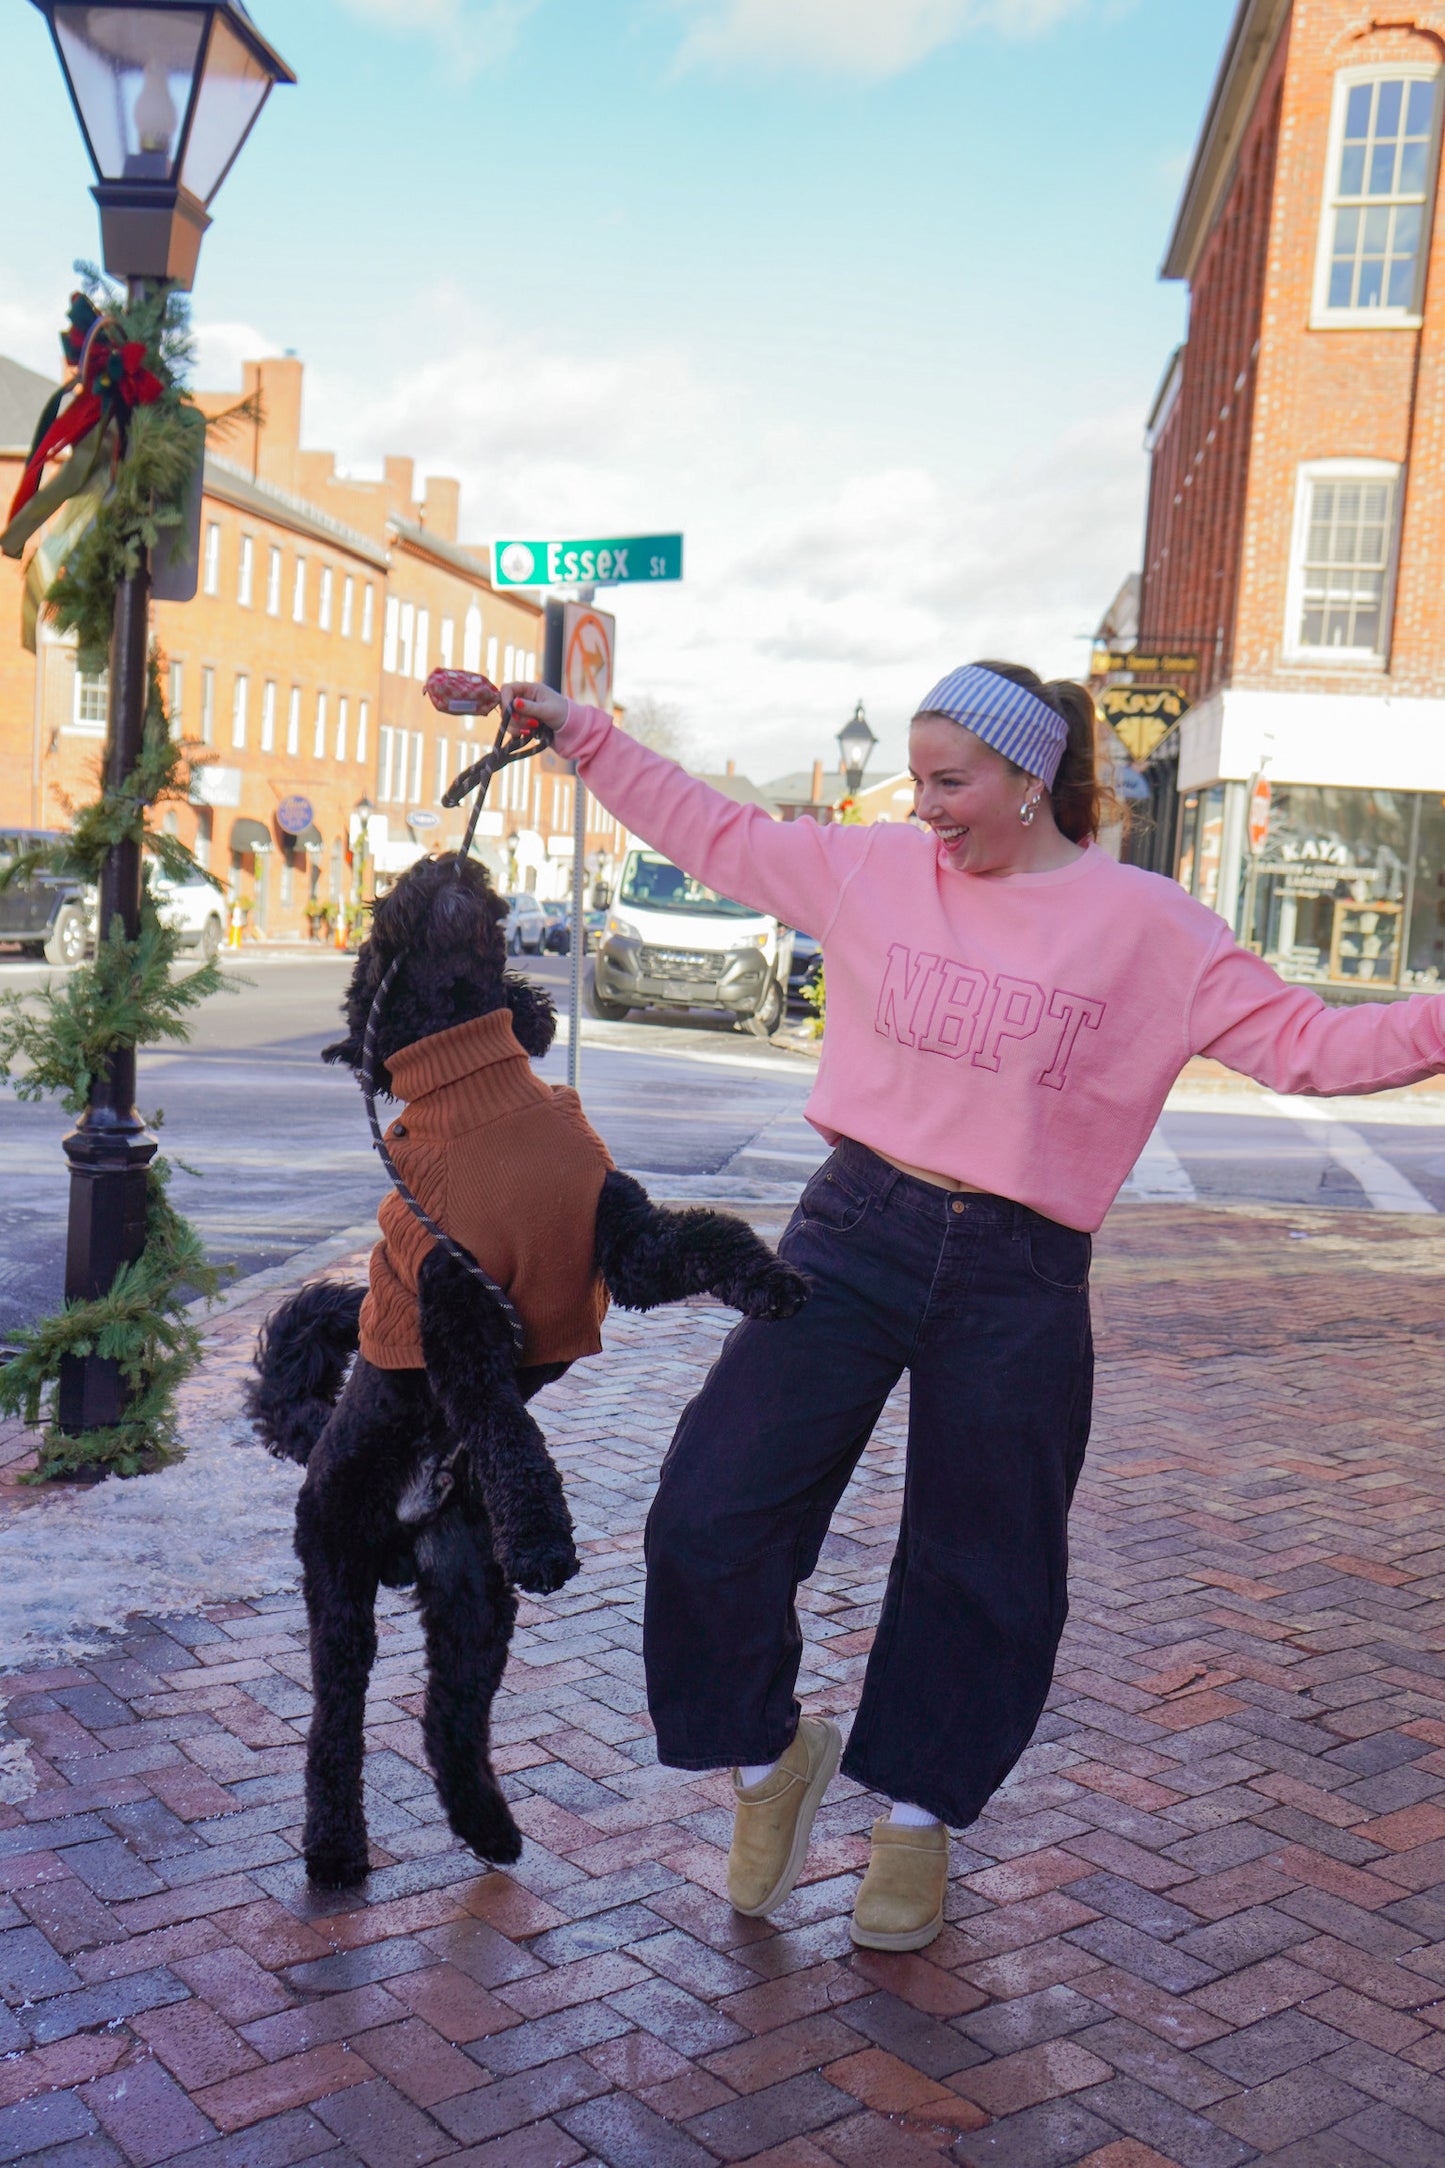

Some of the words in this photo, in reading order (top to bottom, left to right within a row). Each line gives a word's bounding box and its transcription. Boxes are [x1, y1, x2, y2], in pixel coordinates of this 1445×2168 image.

[547, 543, 629, 582] Essex
[650, 556, 666, 577] St
[1282, 840, 1348, 865] KAYA
[875, 942, 1106, 1091] NBPT
